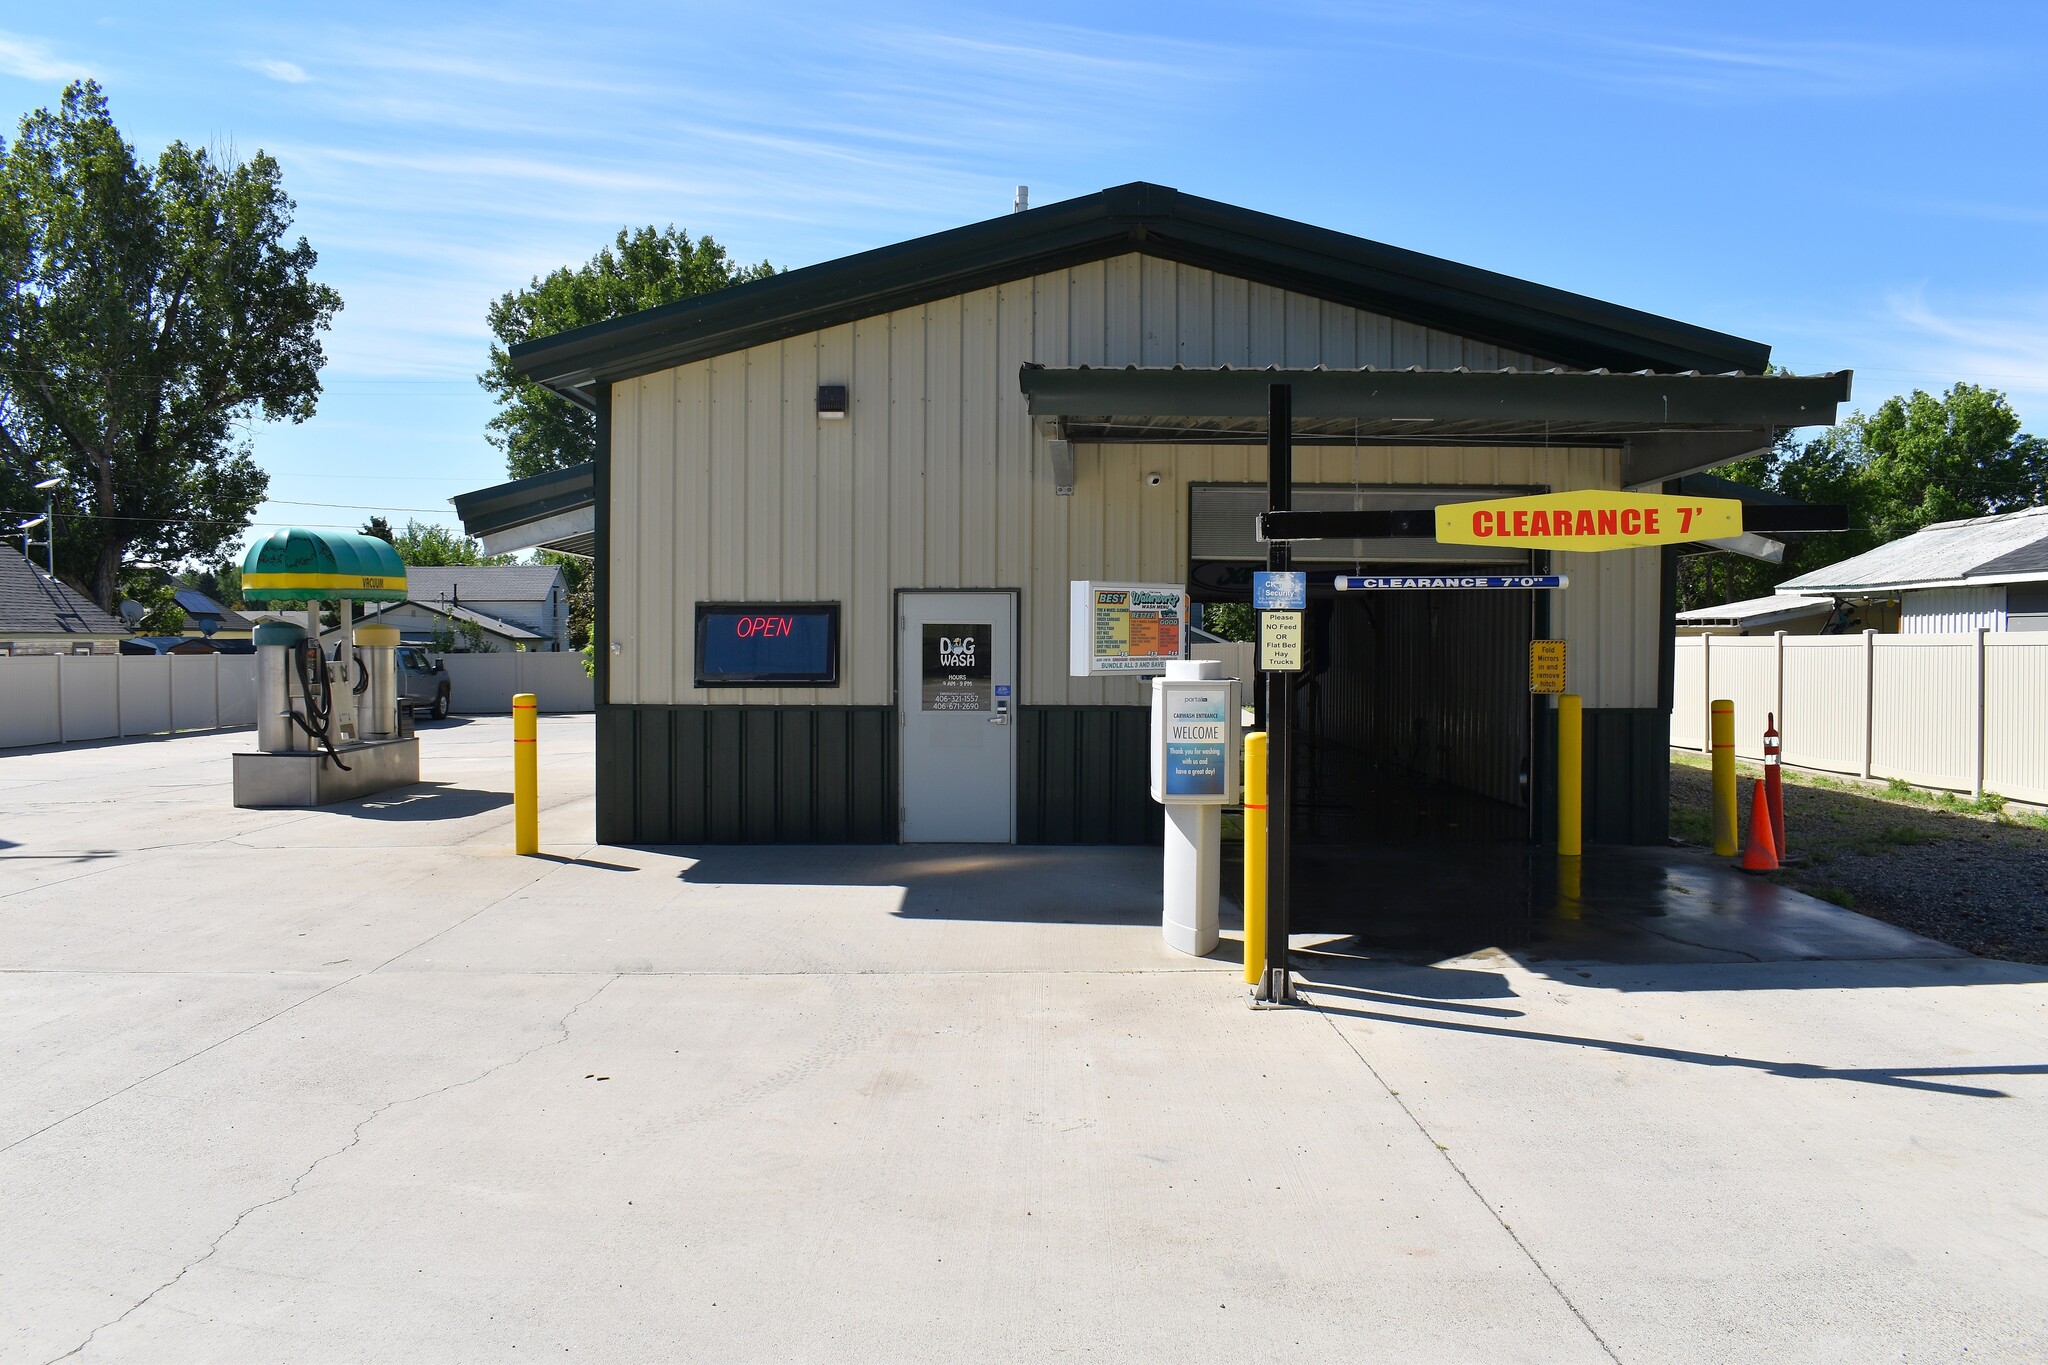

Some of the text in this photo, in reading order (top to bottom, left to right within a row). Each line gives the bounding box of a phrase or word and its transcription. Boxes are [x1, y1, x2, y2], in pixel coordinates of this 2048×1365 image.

[1472, 507, 1703, 537] CLEARANCE 7'
[362, 577, 384, 589] VACUUM
[1363, 577, 1488, 588] CLEARANCE
[1099, 594, 1126, 603] BEST
[1265, 589, 1295, 598] Security
[736, 617, 793, 638] OPEN
[940, 654, 975, 666] WASH
[1173, 726, 1218, 739] WELCOME
[1205, 768, 1215, 776] day!
